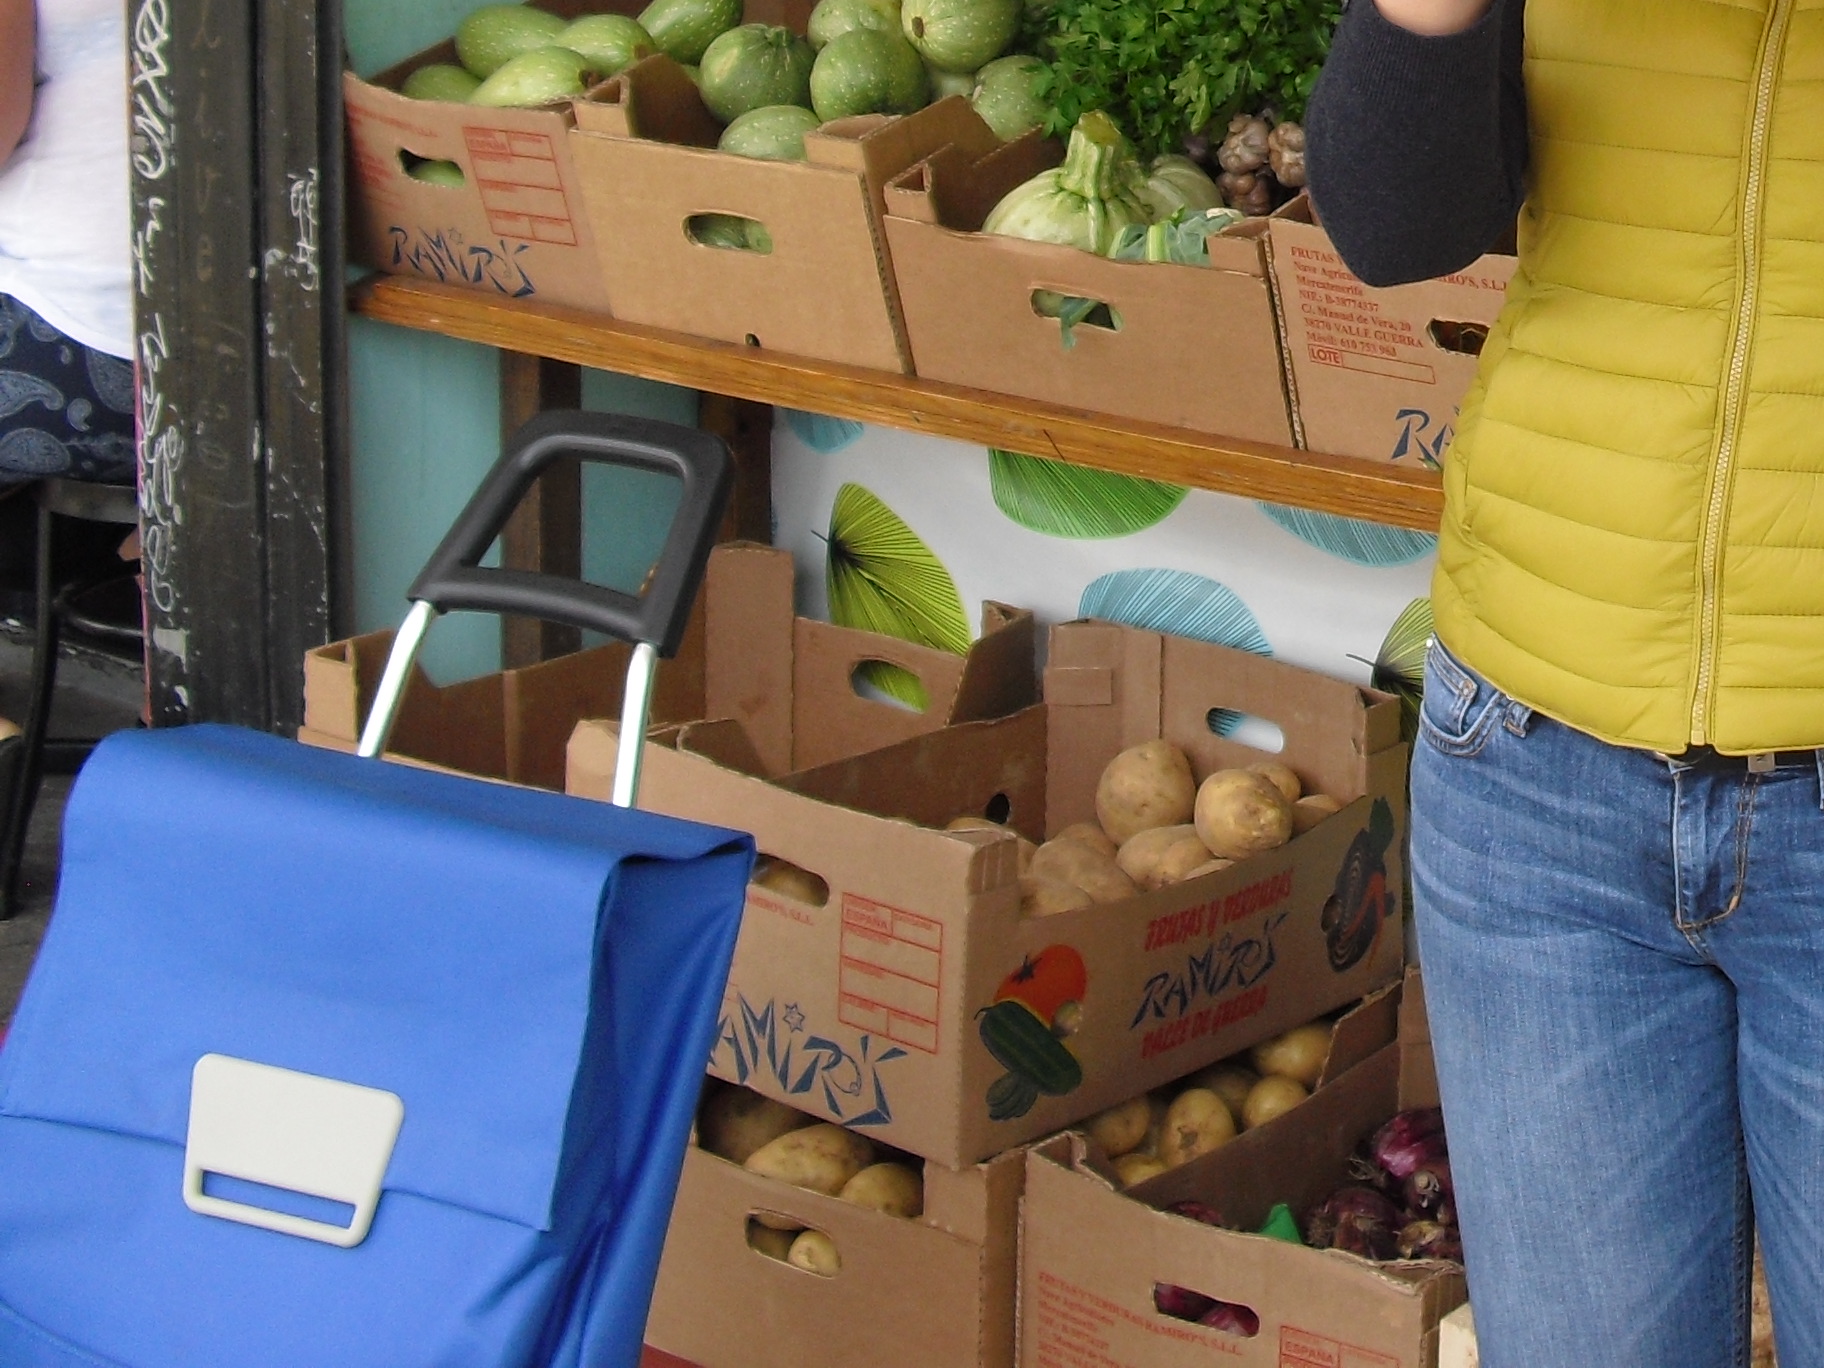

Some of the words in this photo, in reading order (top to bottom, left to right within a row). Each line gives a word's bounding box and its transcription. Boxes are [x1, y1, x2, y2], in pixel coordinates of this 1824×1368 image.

[1291, 246, 1334, 262] FRUTAS
[1357, 314, 1369, 324] de
[1374, 330, 1424, 348] GUERRA
[1311, 348, 1340, 364] LOTE
